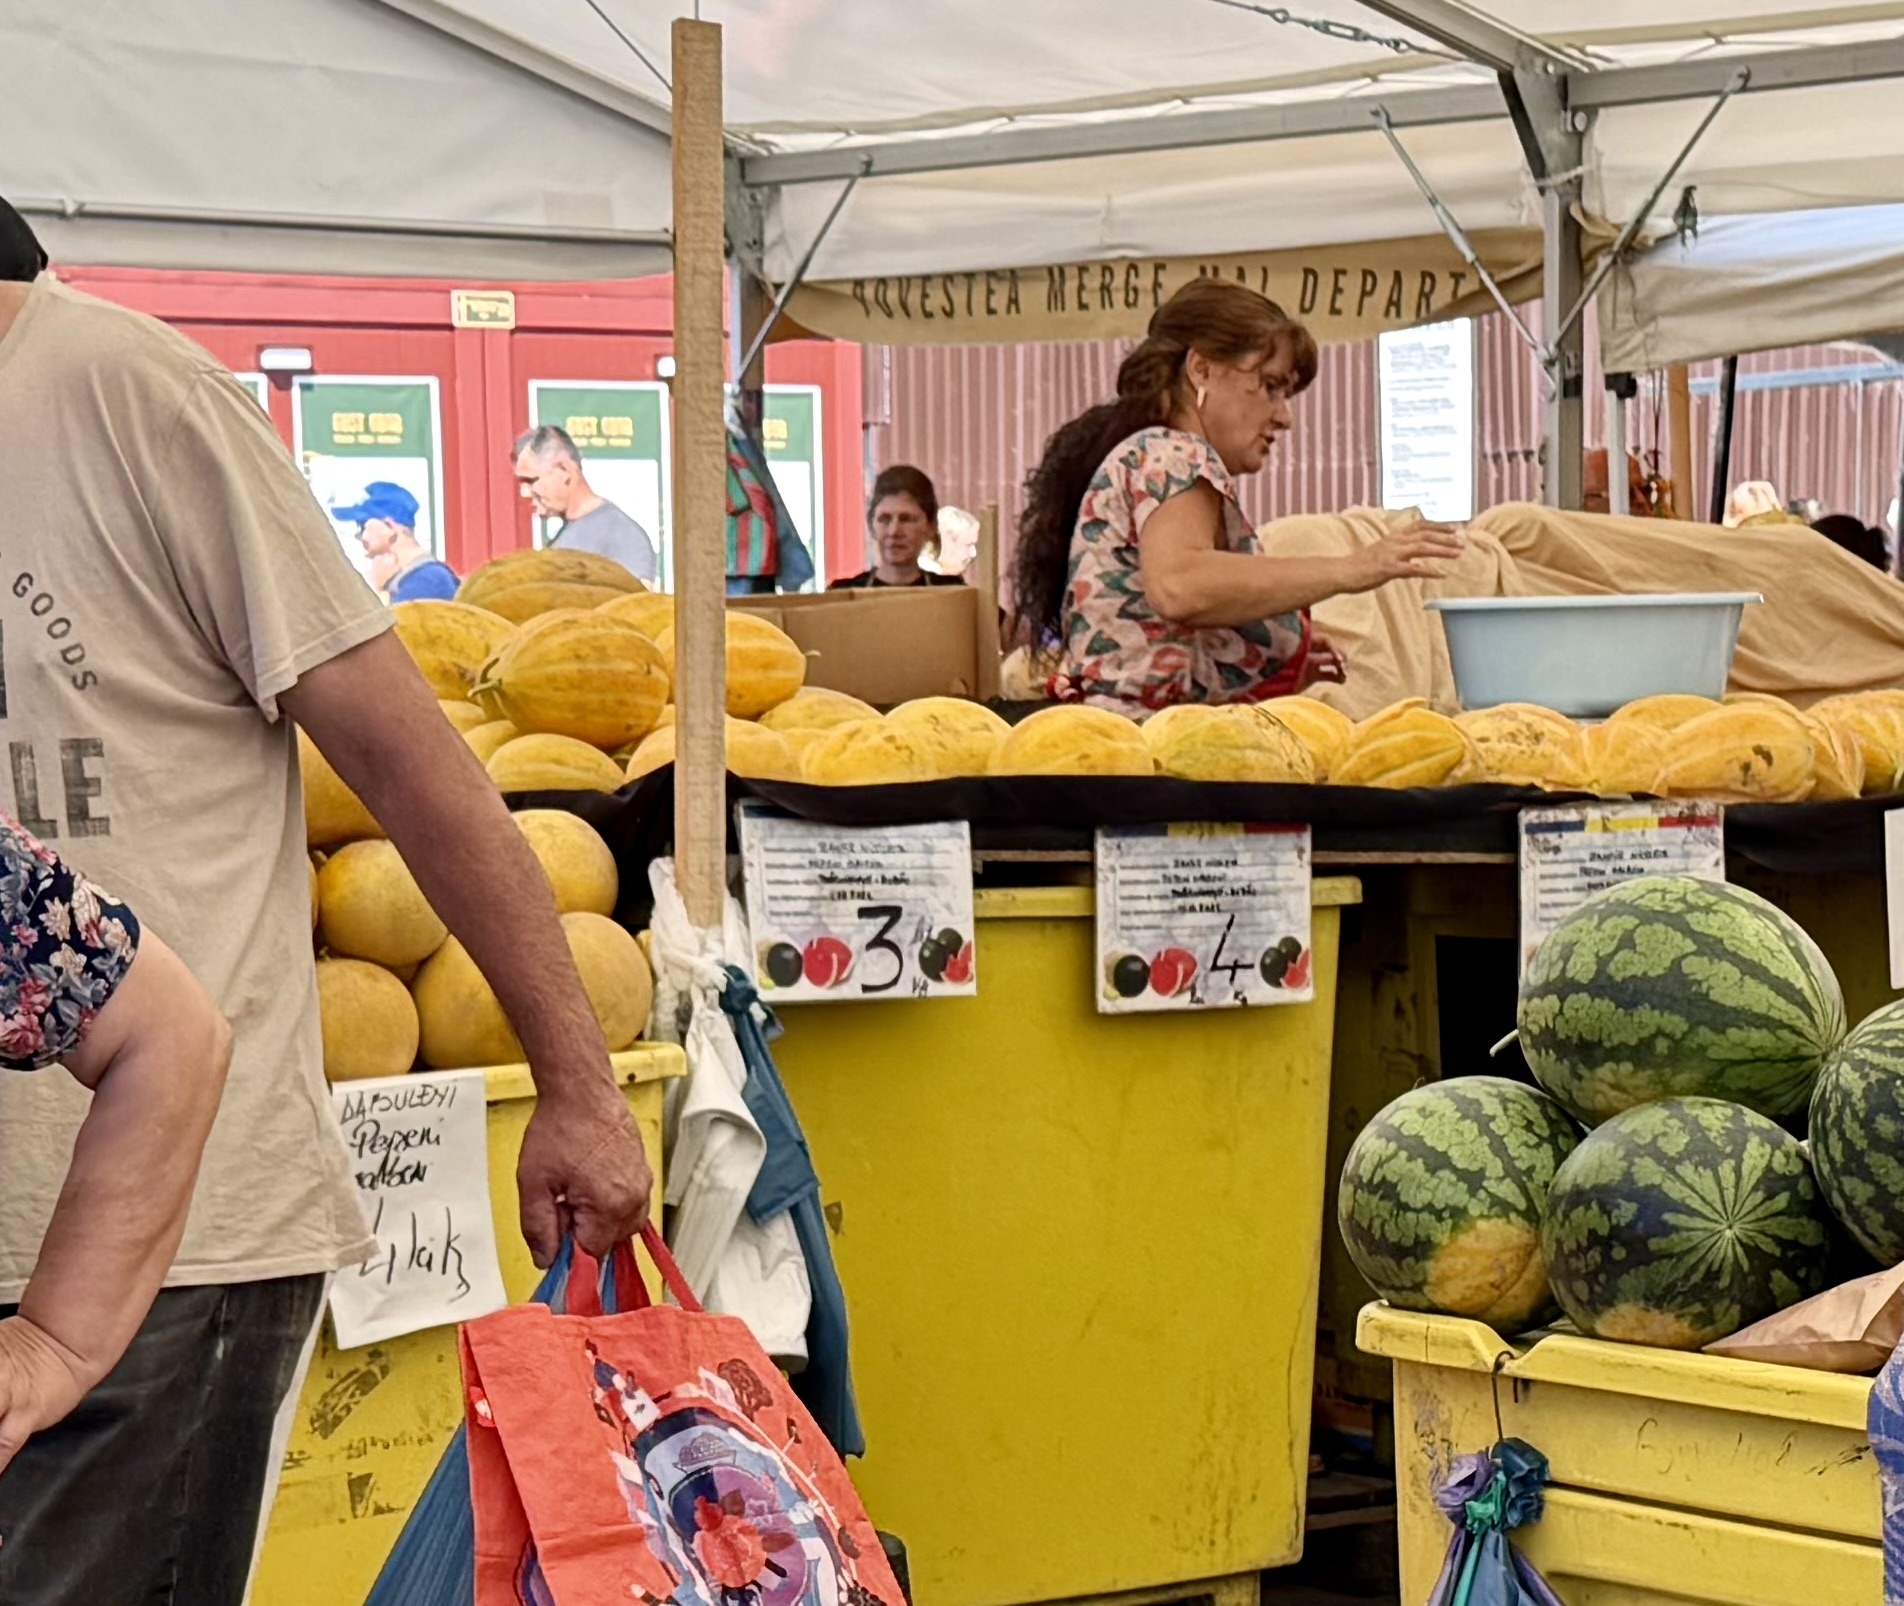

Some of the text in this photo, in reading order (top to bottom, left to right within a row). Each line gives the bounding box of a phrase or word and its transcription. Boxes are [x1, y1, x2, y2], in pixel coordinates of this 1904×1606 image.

[12, 571, 98, 692] GOODS
[857, 905, 904, 994] 3
[1209, 913, 1255, 985] 4
